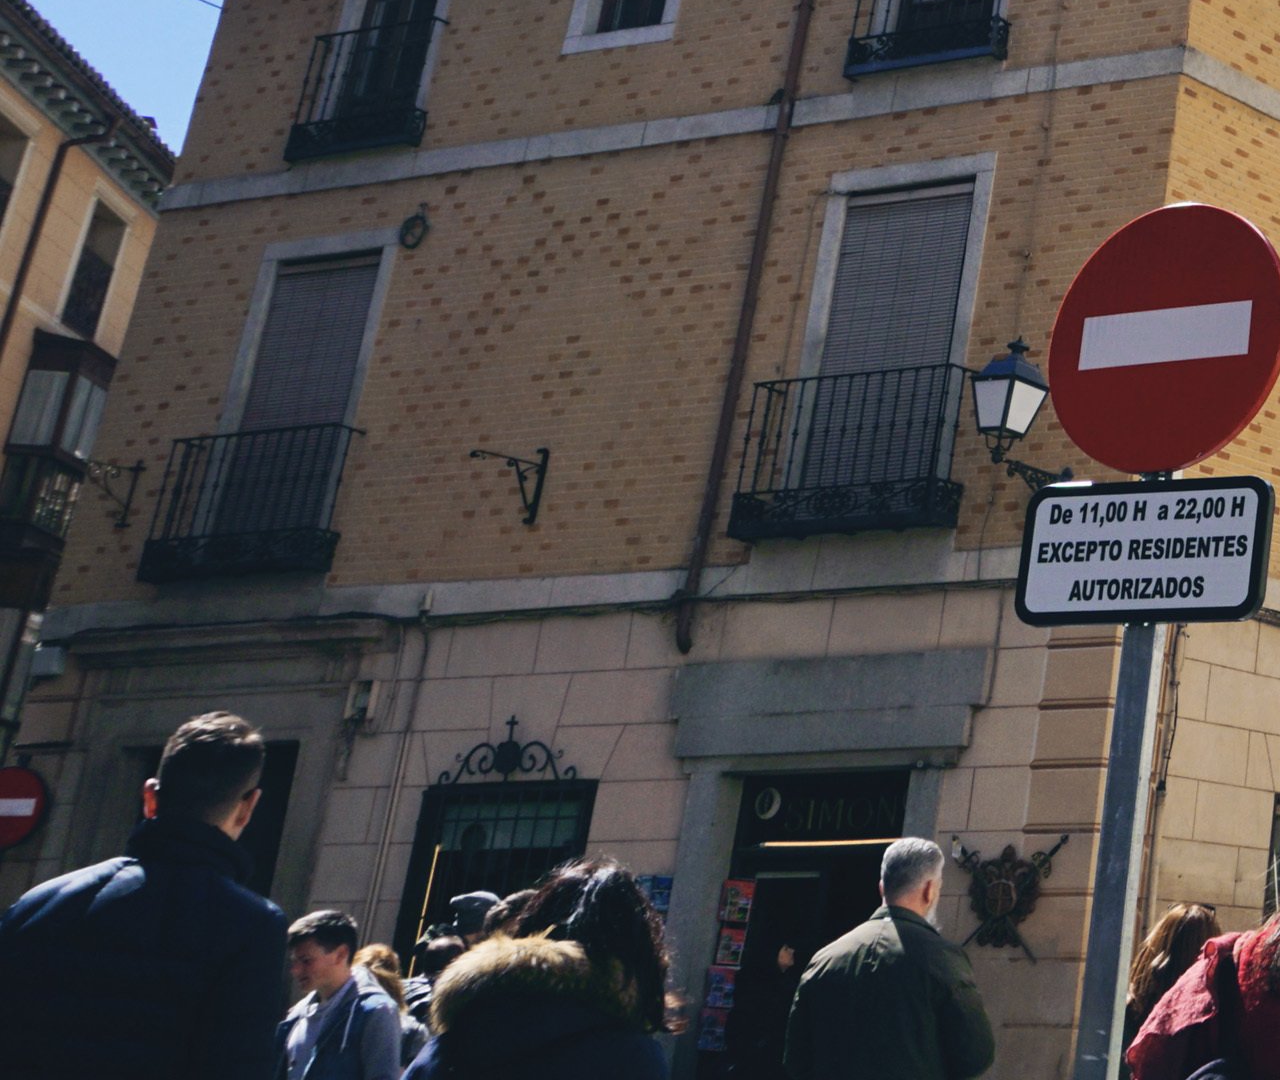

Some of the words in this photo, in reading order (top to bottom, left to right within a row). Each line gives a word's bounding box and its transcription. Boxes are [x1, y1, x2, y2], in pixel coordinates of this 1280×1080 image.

[1049, 504, 1073, 525] De
[1079, 501, 1128, 527] 11,00
[1132, 500, 1147, 522] H
[1157, 504, 1169, 521] a
[1174, 496, 1226, 524] 22,00
[1230, 496, 1246, 517] H
[1037, 539, 1123, 564] EXCEPTO
[1127, 535, 1248, 560] RESIDENTES
[1068, 575, 1205, 602] AUTORIZADOS
